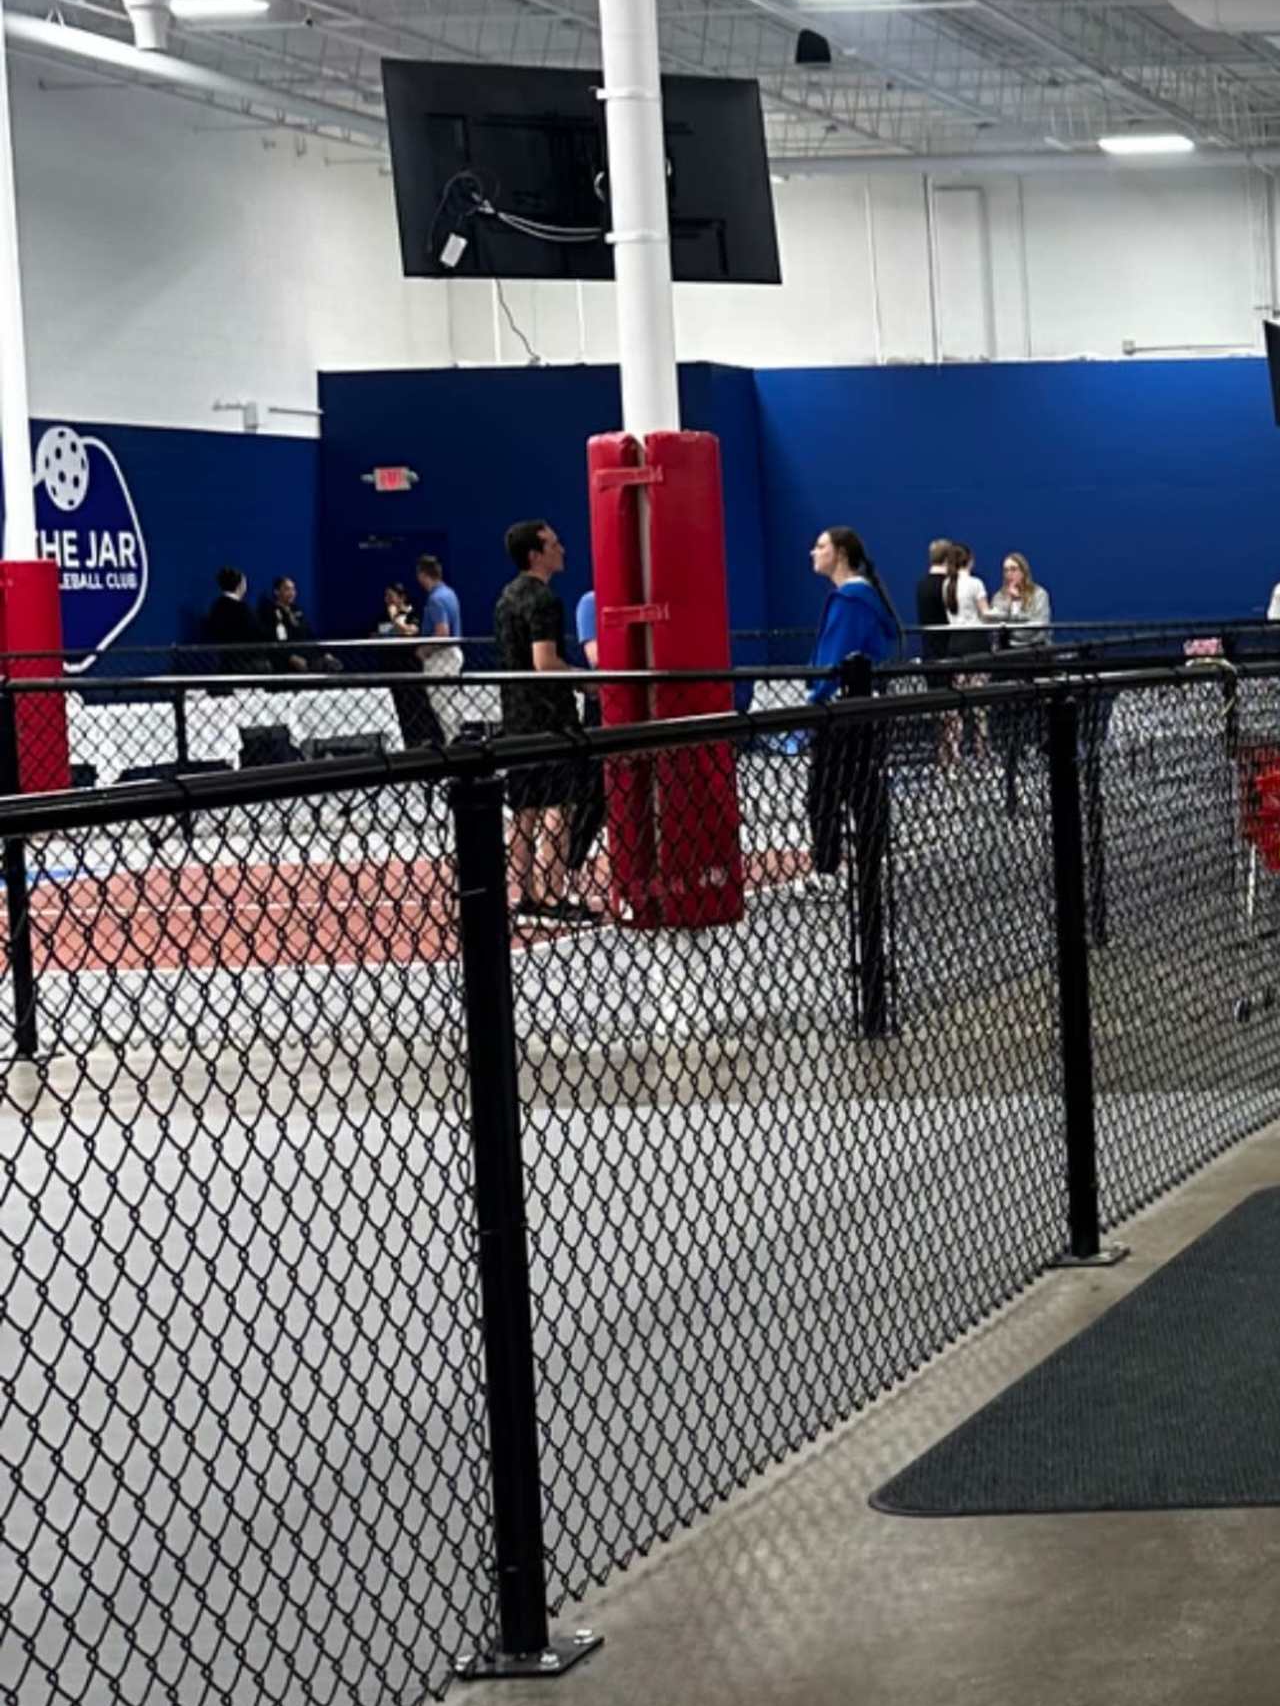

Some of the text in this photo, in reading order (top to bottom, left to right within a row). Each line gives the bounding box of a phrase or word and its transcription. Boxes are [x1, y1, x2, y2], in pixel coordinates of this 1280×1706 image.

[37, 529, 138, 569] HE JAR
[106, 572, 138, 590] CLUB
